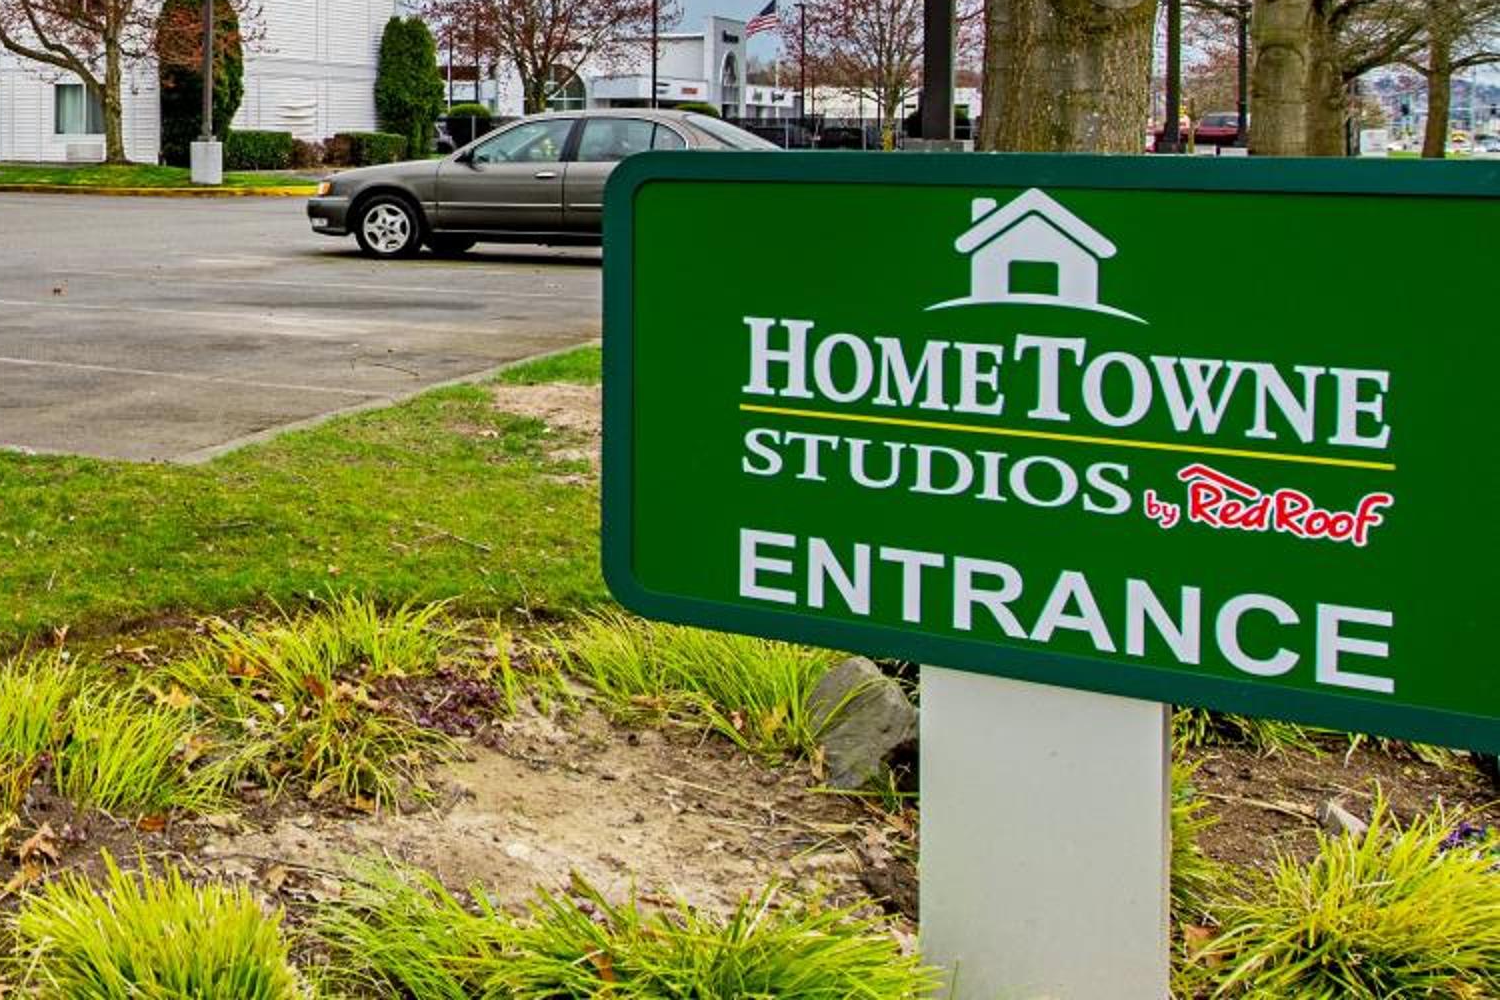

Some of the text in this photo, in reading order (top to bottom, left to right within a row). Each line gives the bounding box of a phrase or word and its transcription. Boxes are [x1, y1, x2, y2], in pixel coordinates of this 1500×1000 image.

[742, 428, 1132, 515] STUDIOS
[1144, 488, 1181, 529] by
[739, 528, 1395, 694] ENTRANCE
